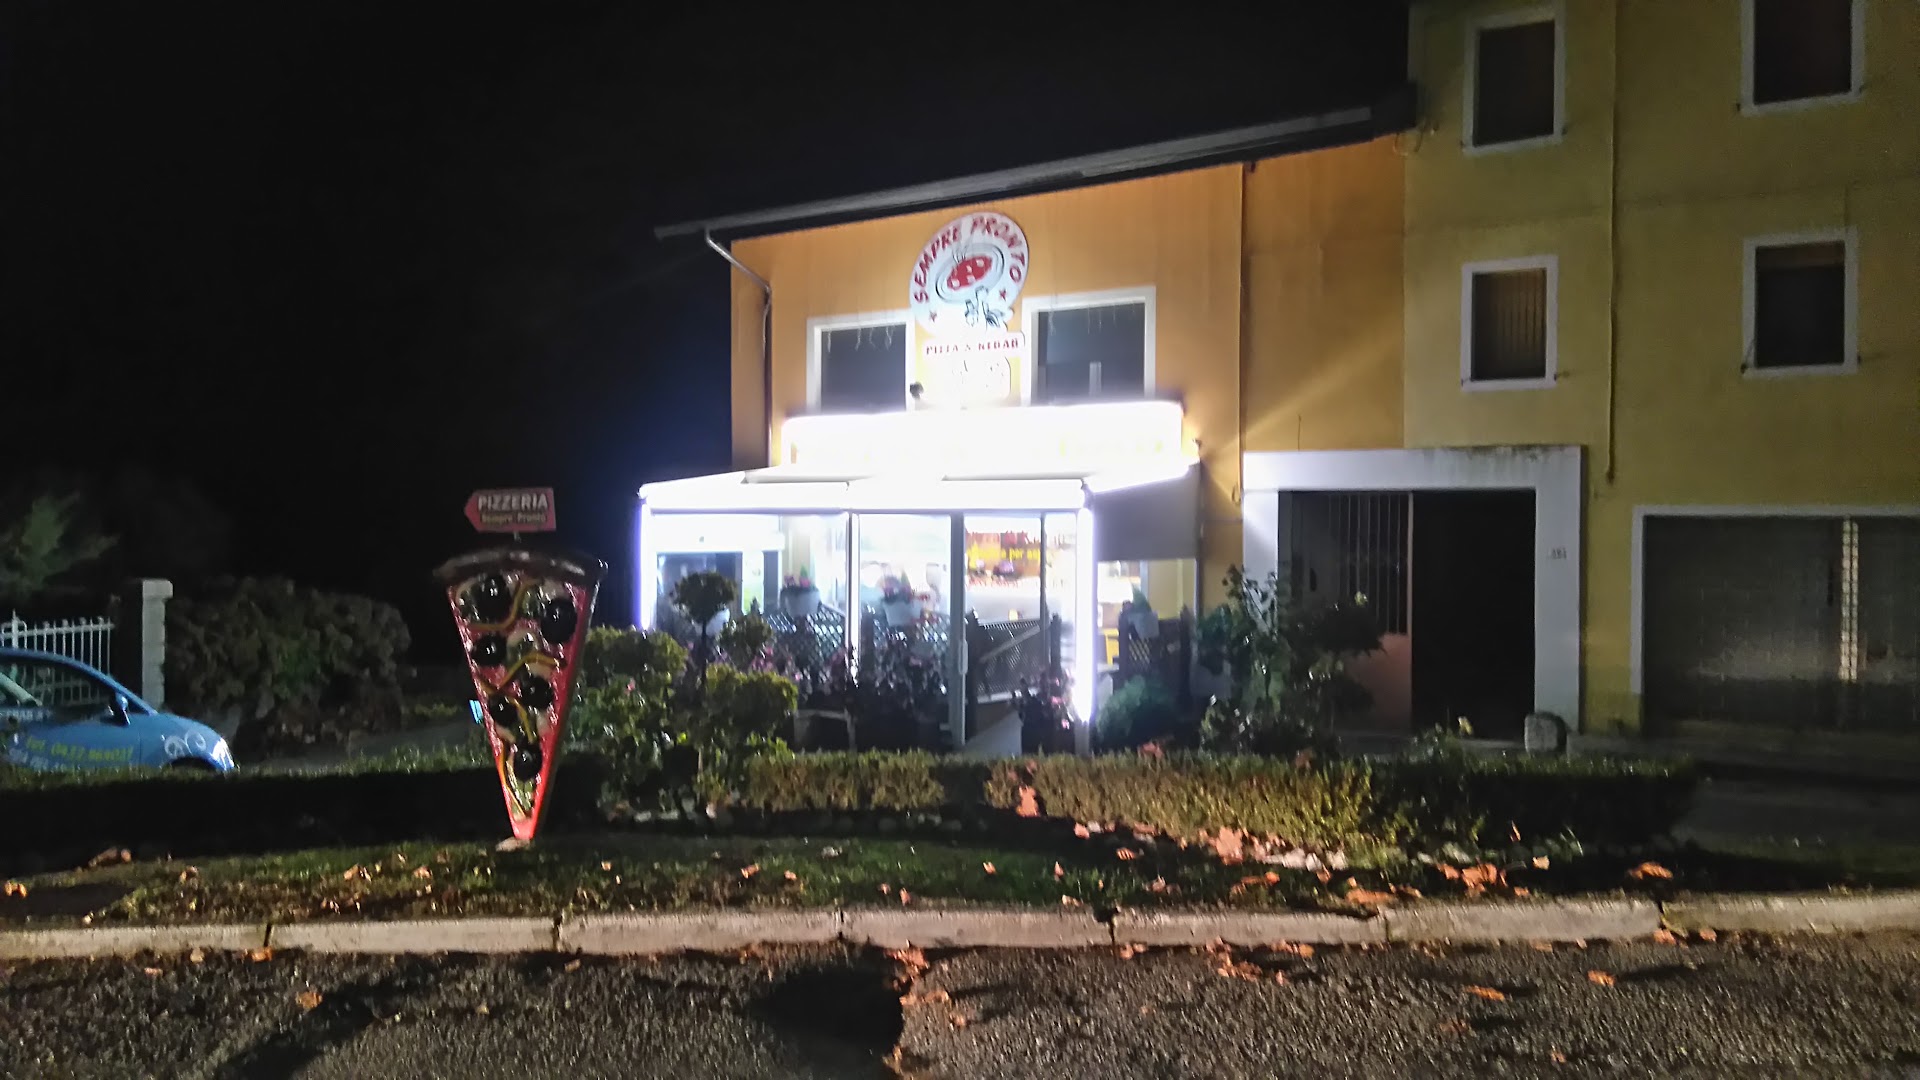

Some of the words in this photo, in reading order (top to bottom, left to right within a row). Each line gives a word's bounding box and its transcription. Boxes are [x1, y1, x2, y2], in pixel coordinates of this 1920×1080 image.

[914, 225, 963, 304] SEMPRE
[970, 215, 1025, 283] PRONTO
[478, 493, 548, 511] PIZZERIA
